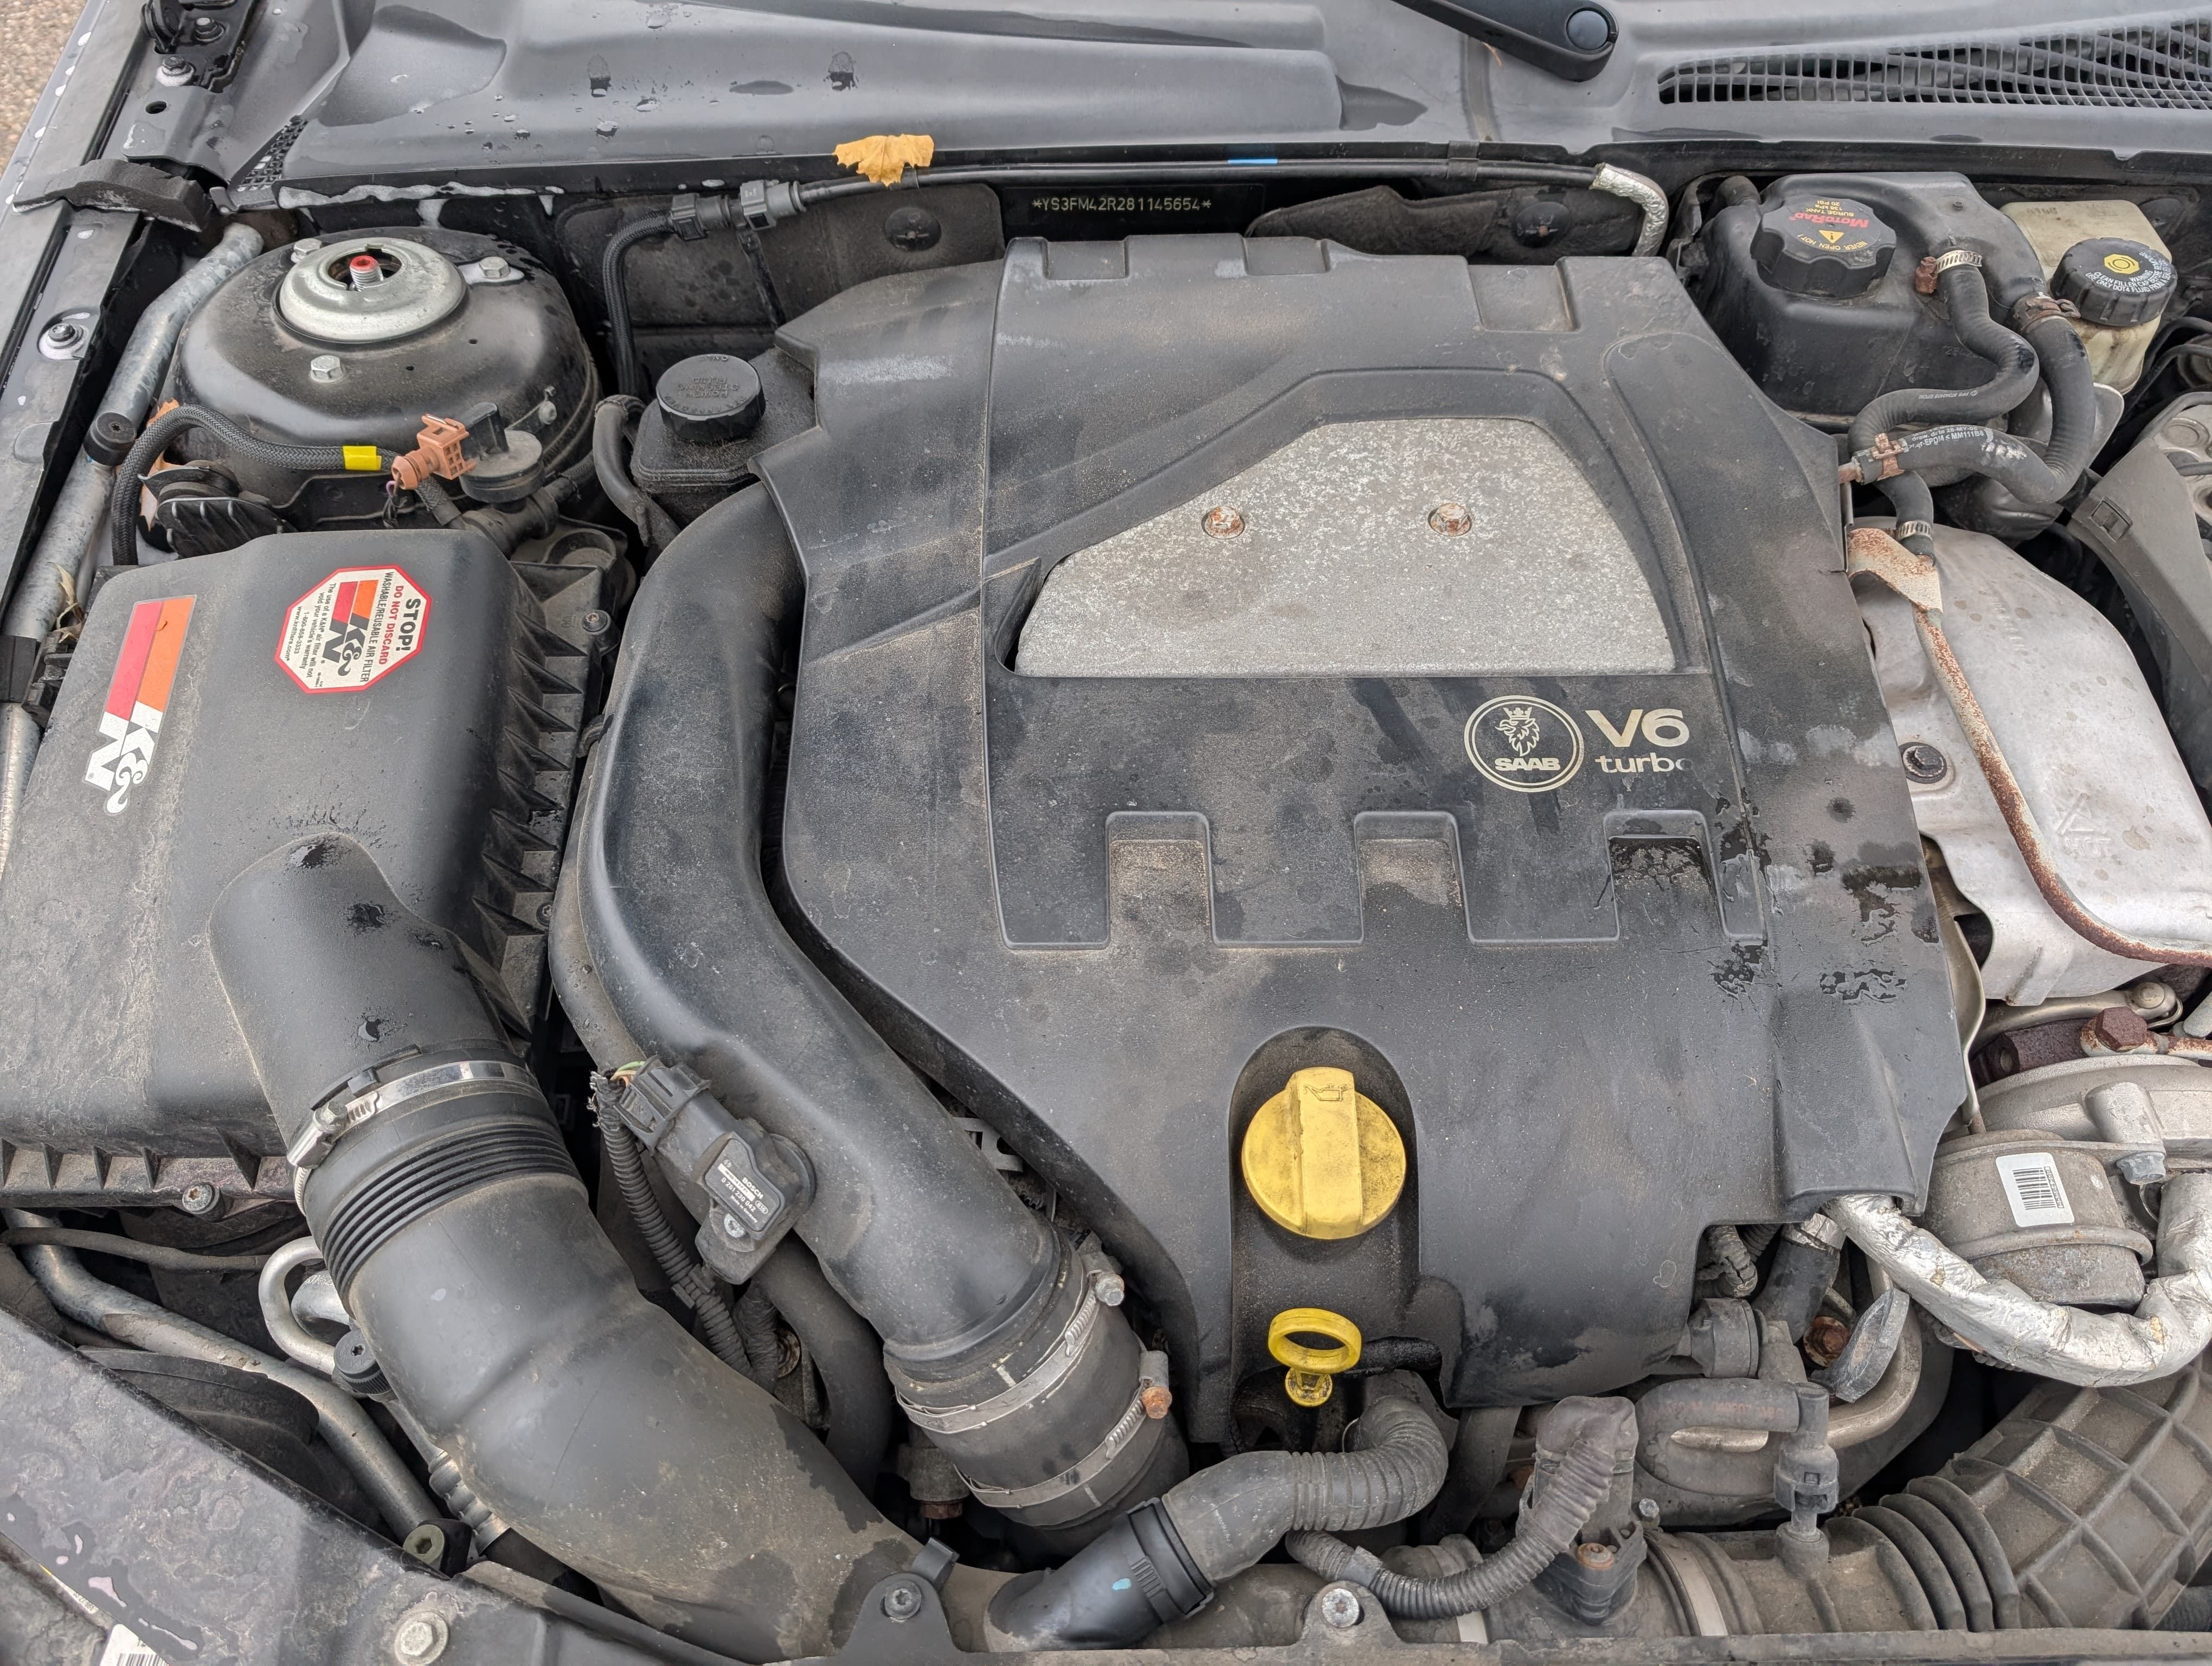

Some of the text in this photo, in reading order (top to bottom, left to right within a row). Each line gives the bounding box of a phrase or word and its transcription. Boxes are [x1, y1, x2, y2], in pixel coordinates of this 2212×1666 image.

[1843, 240, 1868, 250] NEVER
[2085, 272, 2096, 281] USE
[2096, 279, 2113, 288] ONLY
[2148, 281, 2165, 290] FROM
[2094, 272, 2114, 283] CLEAN
[2147, 270, 2163, 283] BEFORE
[2129, 270, 2153, 282] WARNING
[328, 583, 336, 593] The
[294, 611, 310, 654] 1-800-858-3333
[307, 619, 318, 643] vehicle's
[360, 572, 394, 682] WASHABLE/REUSABLE AIR FILTER
[378, 586, 404, 665] DO NOT DISCARD
[396, 598, 421, 651] STOP!
[299, 644, 311, 669] warranty
[312, 643, 321, 655] filter
[1584, 708, 1690, 747] V6
[85, 701, 163, 813] K&N
[1495, 758, 1560, 771] SAAB
[726, 1182, 736, 1191] 261
[735, 1190, 745, 1202] 230
[745, 1201, 756, 1212] 042
[742, 1177, 763, 1199] BOSCH
[731, 1195, 740, 1205] Made
[743, 1208, 757, 1223] Germany
